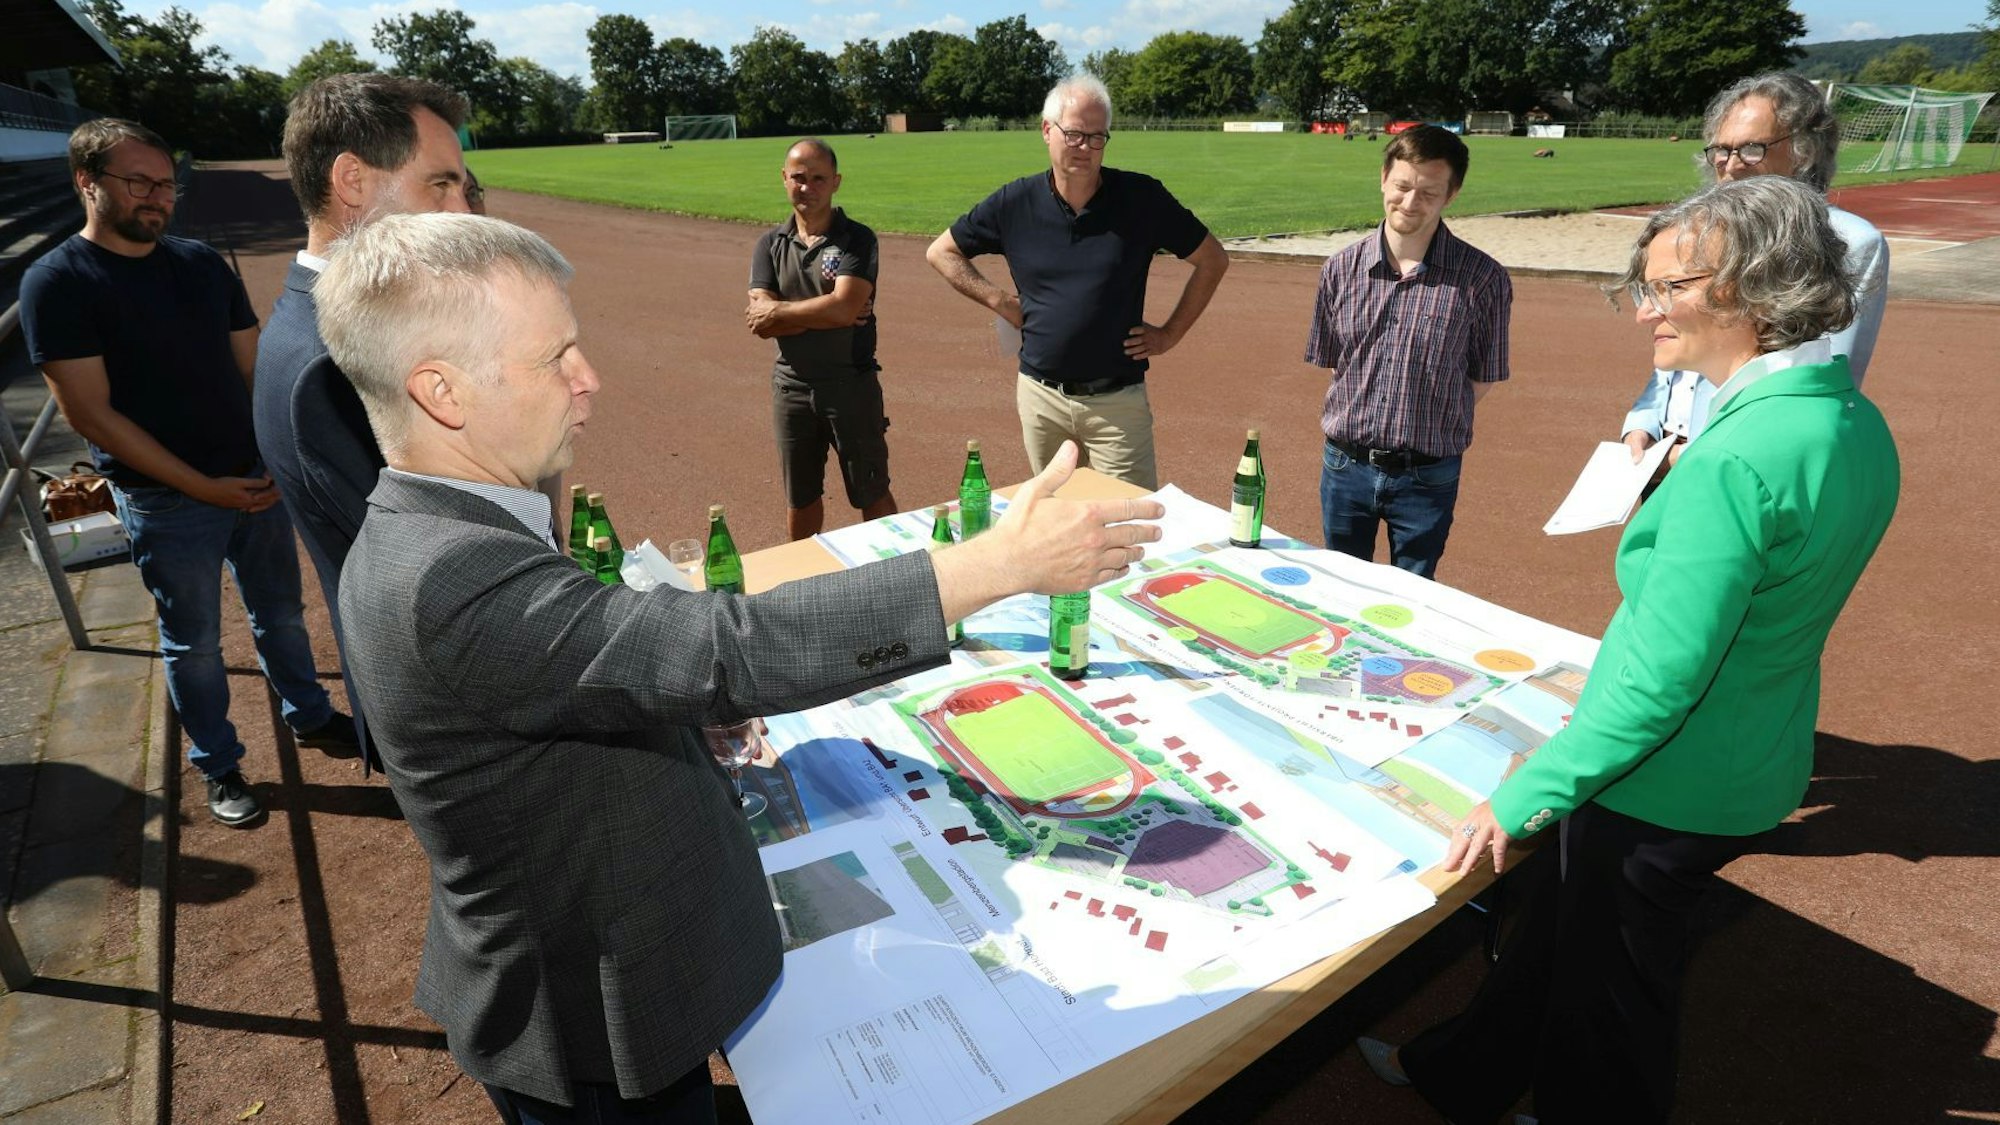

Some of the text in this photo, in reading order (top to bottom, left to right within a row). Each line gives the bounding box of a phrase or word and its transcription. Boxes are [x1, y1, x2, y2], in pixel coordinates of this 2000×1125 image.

[907, 812, 931, 837] Entwurf
[1038, 966, 1058, 983] Bad
[1051, 983, 1077, 1006] Stadt
